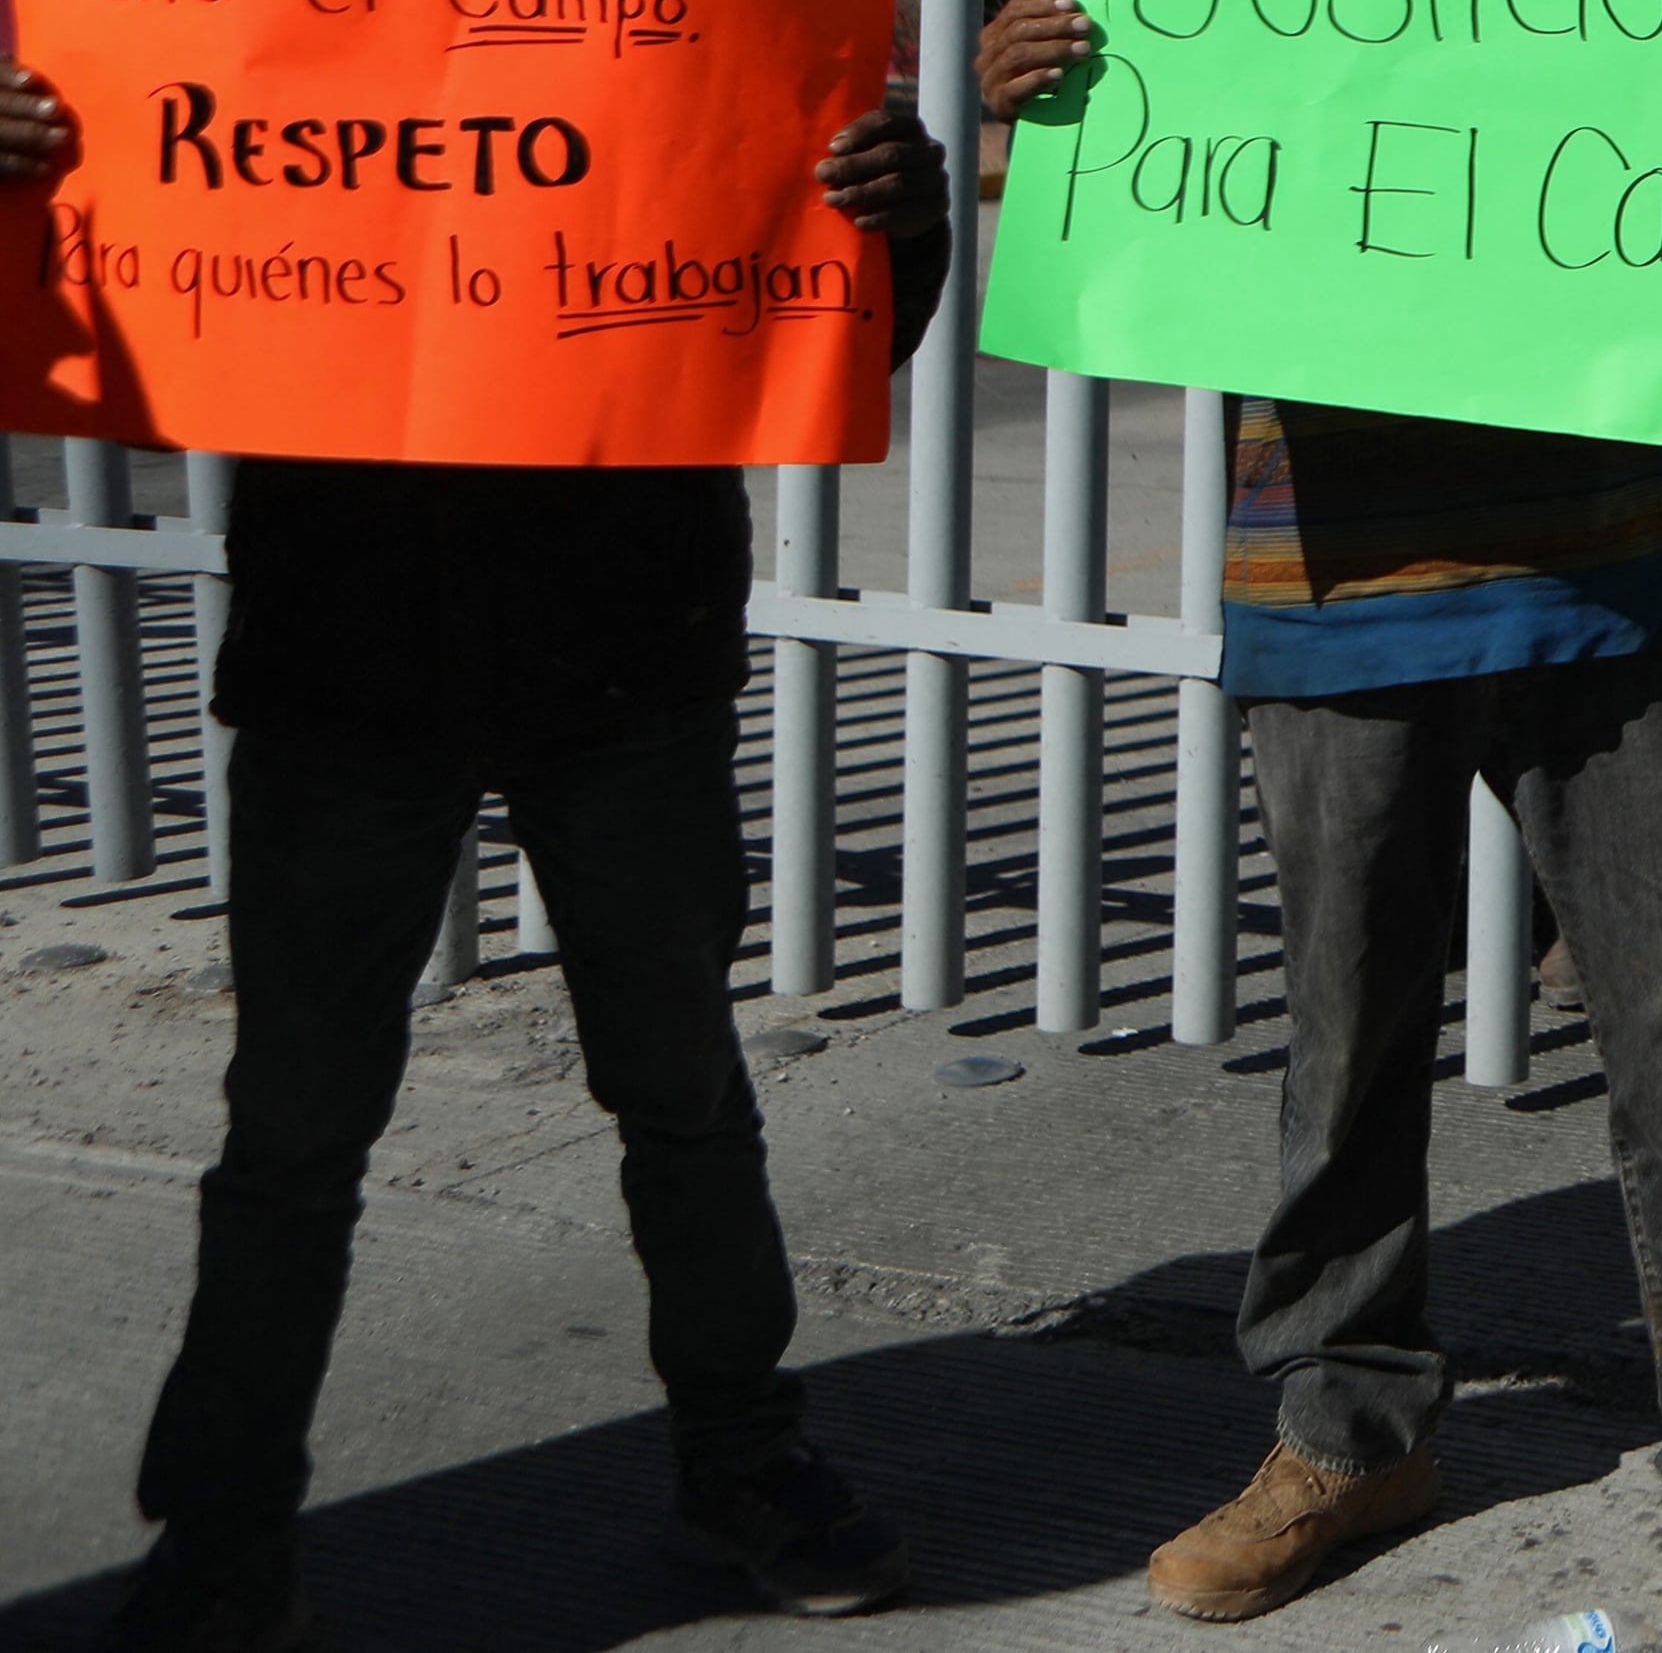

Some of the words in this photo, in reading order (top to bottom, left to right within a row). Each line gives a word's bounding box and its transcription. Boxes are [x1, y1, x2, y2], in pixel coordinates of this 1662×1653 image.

[147, 80, 593, 195] RESPETO
[1061, 53, 1282, 241] Para
[1349, 120, 1479, 260] El
[40, 202, 140, 289] Para
[172, 242, 403, 339] quiénes
[450, 233, 501, 308] lo
